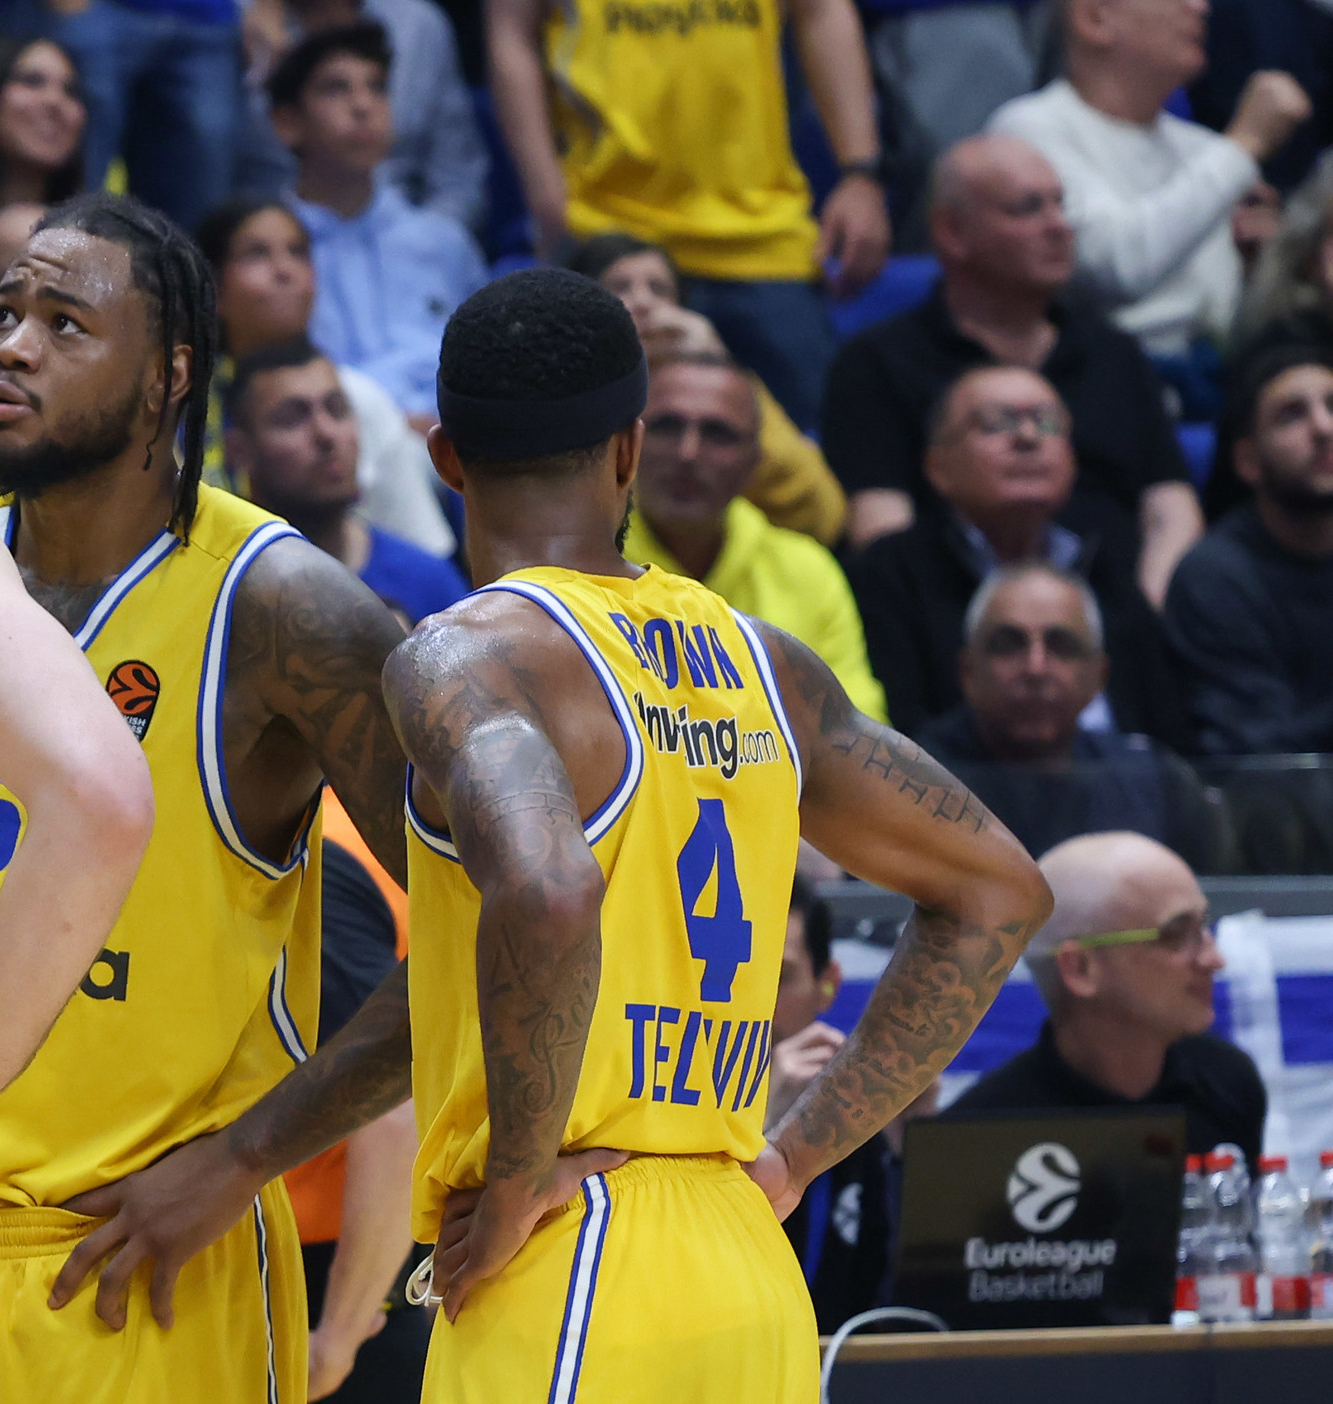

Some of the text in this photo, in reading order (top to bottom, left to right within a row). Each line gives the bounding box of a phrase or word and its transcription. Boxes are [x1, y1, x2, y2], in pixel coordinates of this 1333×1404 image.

[634, 690, 780, 780] Inving.com
[677, 798, 753, 1003] 4
[625, 1003, 703, 1107] TEL
[703, 1018, 771, 1113] VIV
[964, 1236, 1117, 1274] Euroleague
